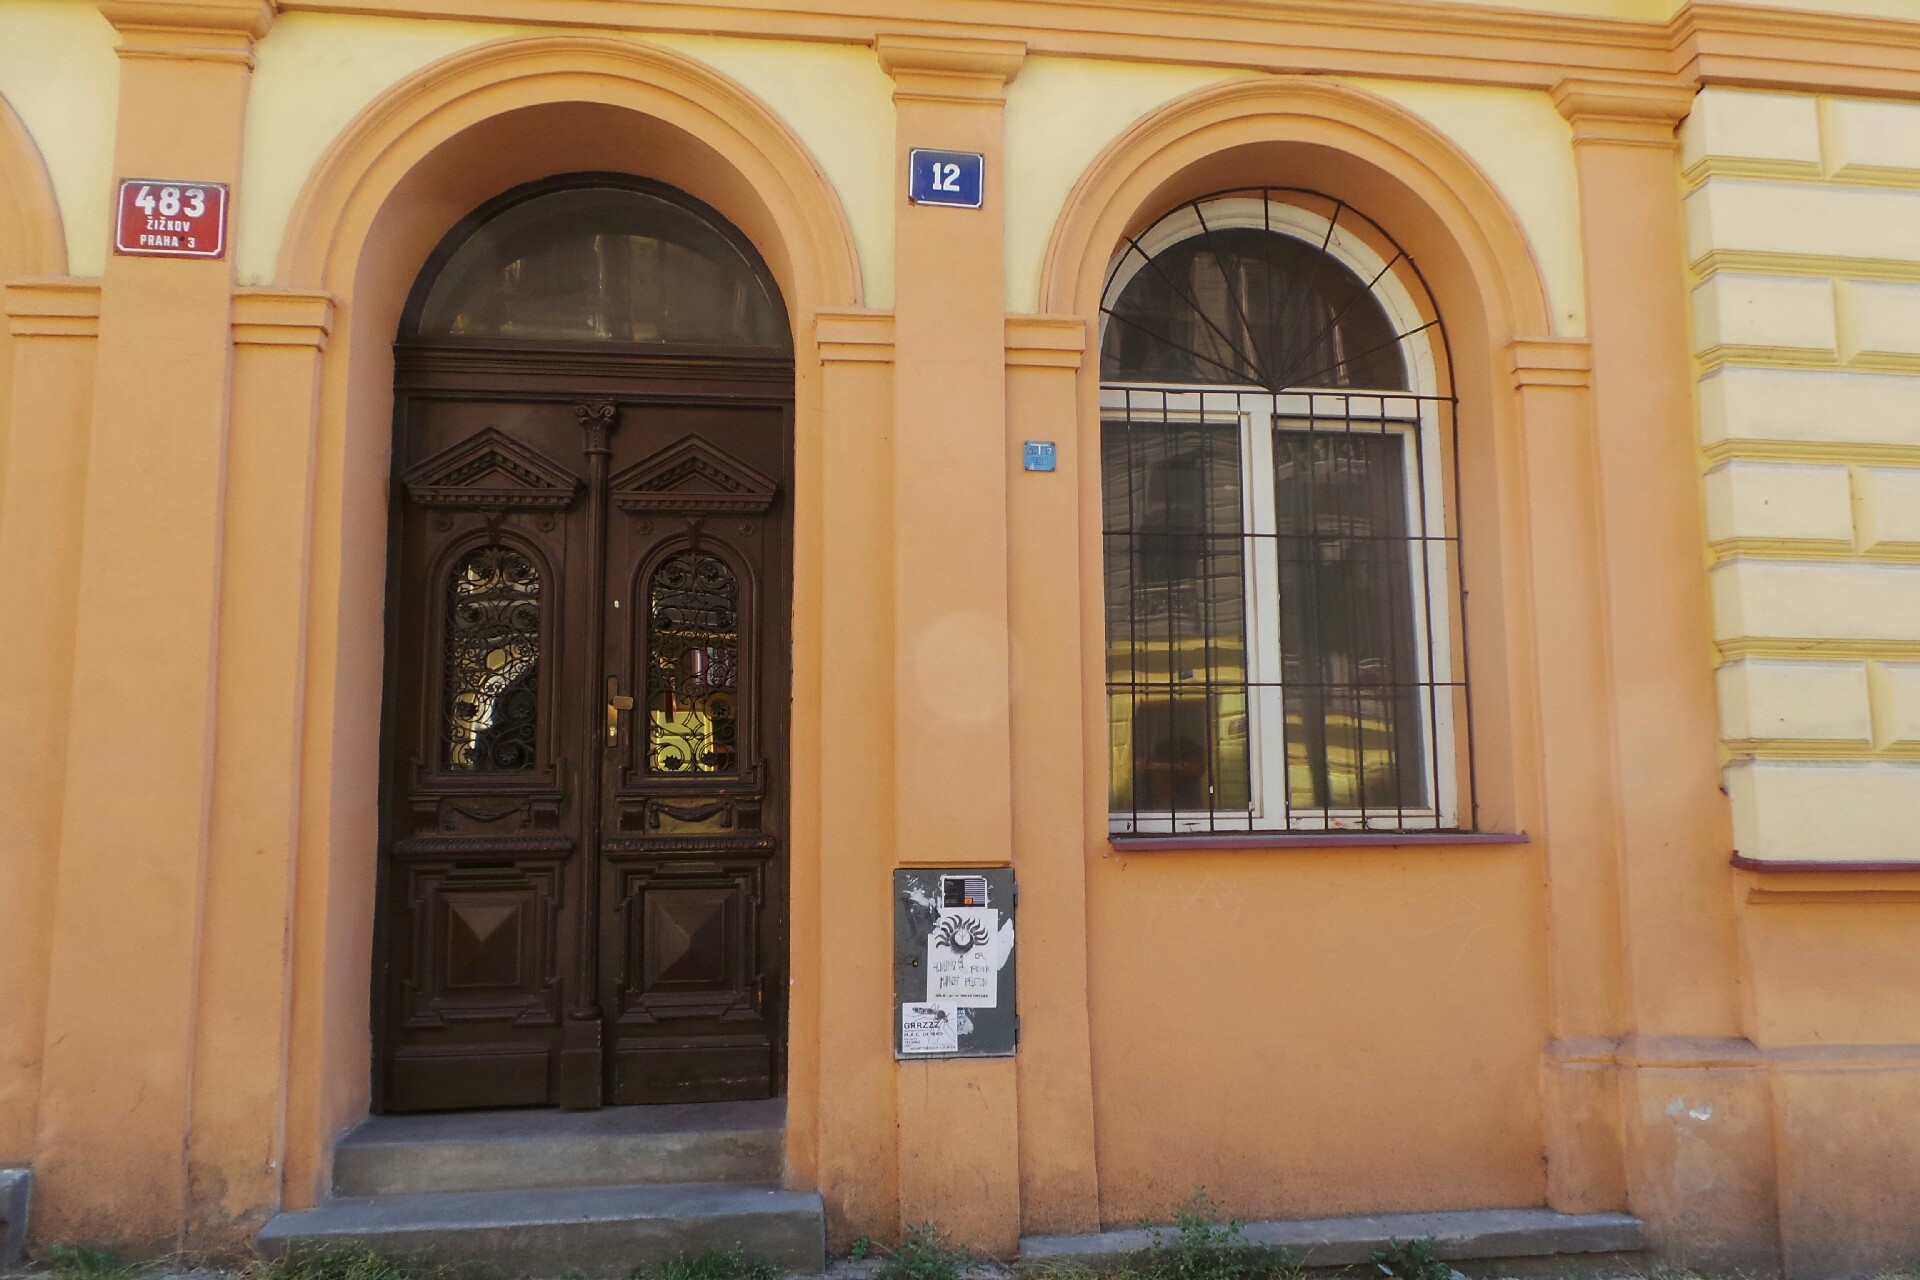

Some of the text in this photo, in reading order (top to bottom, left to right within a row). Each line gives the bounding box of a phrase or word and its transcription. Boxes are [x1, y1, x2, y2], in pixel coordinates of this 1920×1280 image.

[933, 162, 960, 192] 12
[135, 185, 206, 217] 483
[146, 216, 191, 232] ŽIŽKOV
[140, 234, 196, 248] PRAHA 3
[903, 1021, 941, 1030] GRRZZZ
